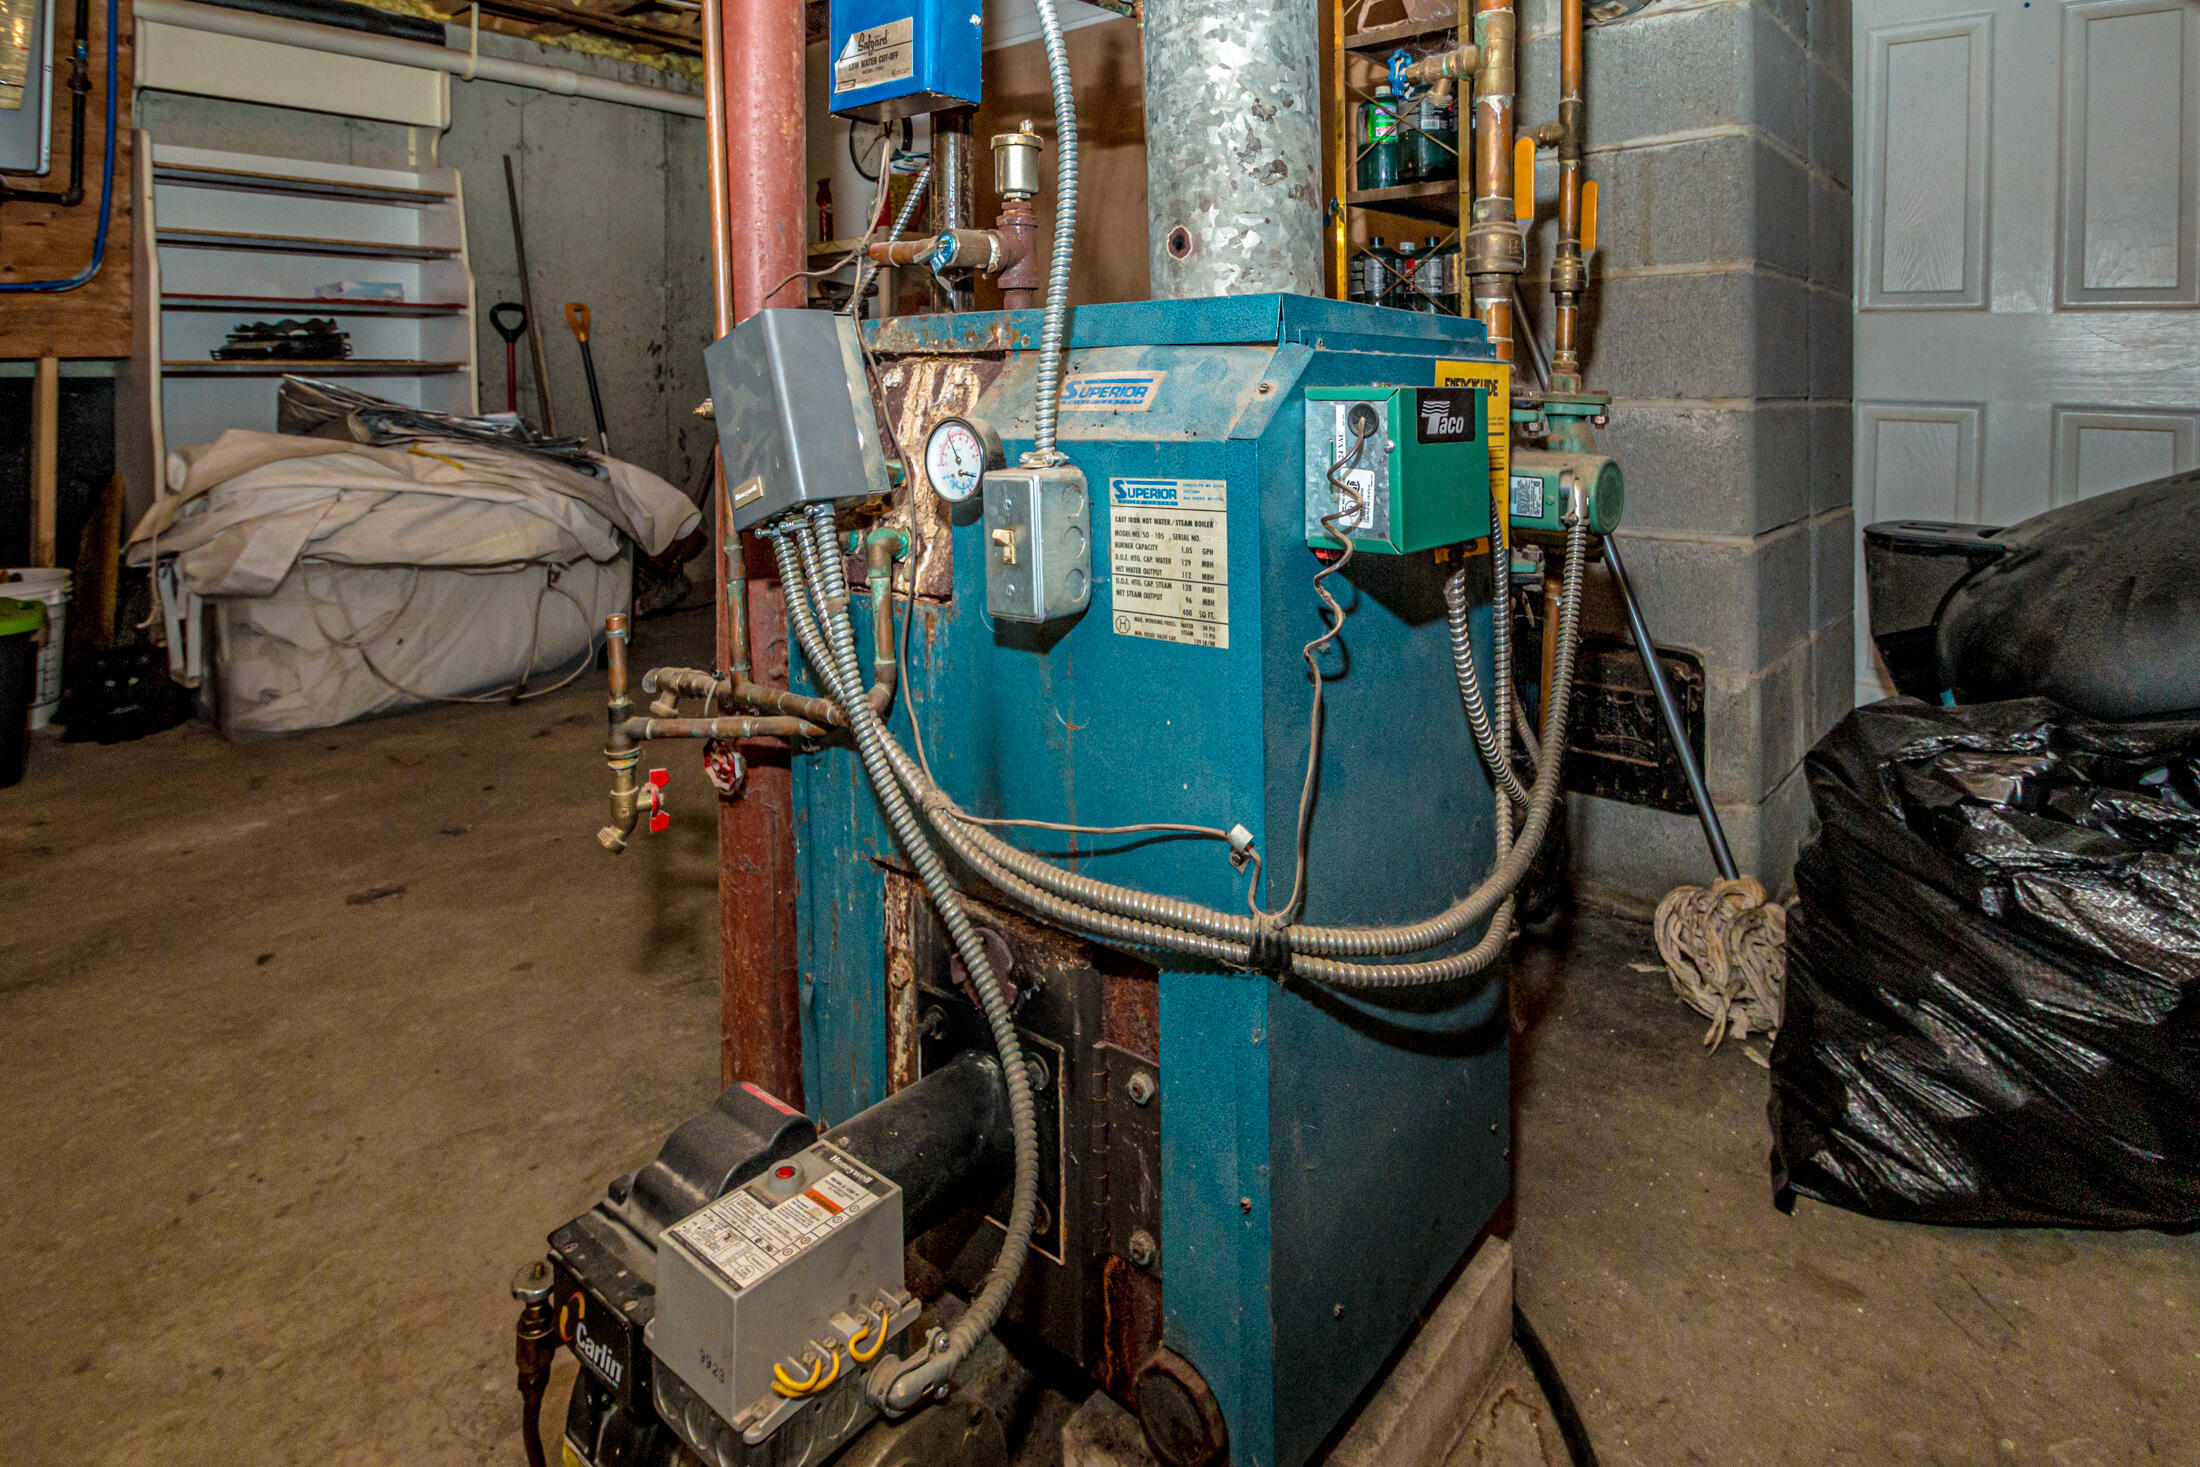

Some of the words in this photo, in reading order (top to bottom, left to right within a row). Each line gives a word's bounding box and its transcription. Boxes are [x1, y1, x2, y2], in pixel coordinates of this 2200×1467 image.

[848, 61, 860, 71] LOW
[860, 56, 877, 68] WATER
[878, 51, 899, 63] CUT-OFF
[1060, 380, 1149, 400] SUPERIOR
[1421, 403, 1465, 435] Taco
[1112, 480, 1177, 500] SUPERIOR
[1128, 516, 1140, 524] IRON
[1142, 517, 1152, 525] HOT
[1194, 520, 1214, 528] BOILER
[1115, 542, 1133, 550] BURNER
[1135, 543, 1158, 551] CAPACITY
[1181, 546, 1193, 554] 1.05
[1202, 547, 1214, 556] GPH
[1115, 553, 1129, 561] D.O.E.
[1155, 556, 1172, 565] WATER
[1202, 561, 1214, 569] MBH
[1116, 565, 1124, 573] NET
[1126, 566, 1142, 574] WATER
[1143, 568, 1162, 576] OUTPUT
[1182, 571, 1191, 579] 112
[1202, 573, 1214, 581] MBH
[1155, 581, 1172, 590] STEAM
[1182, 583, 1192, 591] 128
[1202, 586, 1215, 594] MBH
[1127, 590, 1142, 598] STEAM
[1143, 591, 1163, 600] OUTPUT
[1202, 598, 1215, 607] MBH
[1182, 609, 1192, 617] 400
[1207, 611, 1216, 619] FT.
[830, 1155, 873, 1184] Honeywell
[811, 1195, 837, 1214] WARNING
[576, 1322, 623, 1383] Carlin
